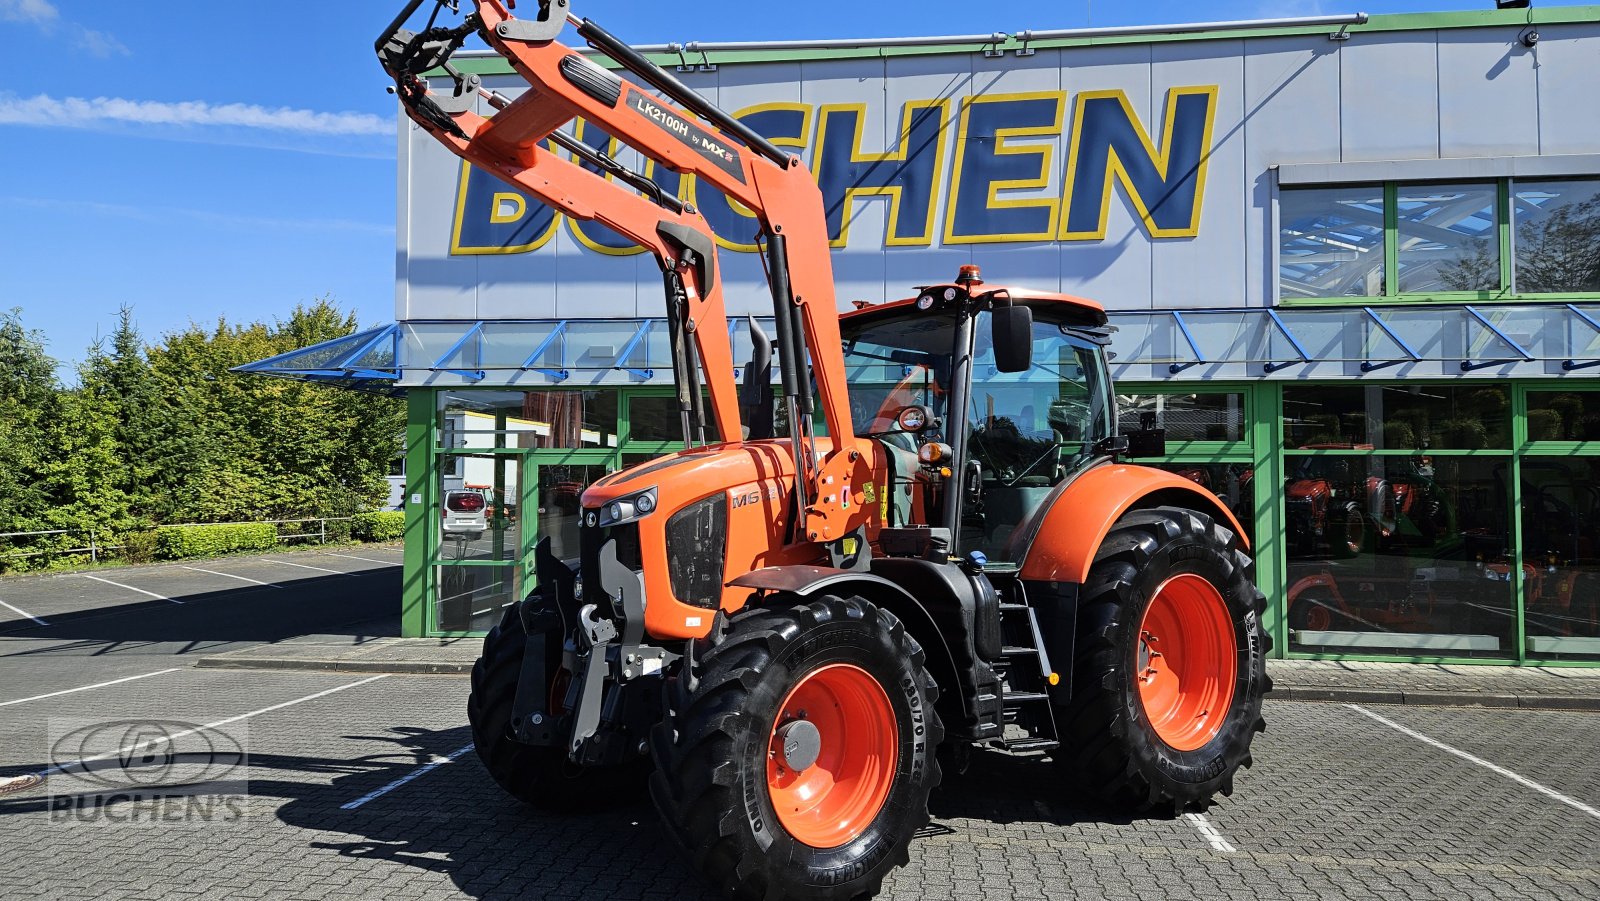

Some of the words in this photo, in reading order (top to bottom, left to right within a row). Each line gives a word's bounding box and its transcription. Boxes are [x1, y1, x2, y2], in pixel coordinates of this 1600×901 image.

[637, 98, 689, 136] LK2100H
[692, 134, 700, 144] by
[702, 138, 726, 158] MX
[915, 742, 925, 754] R
